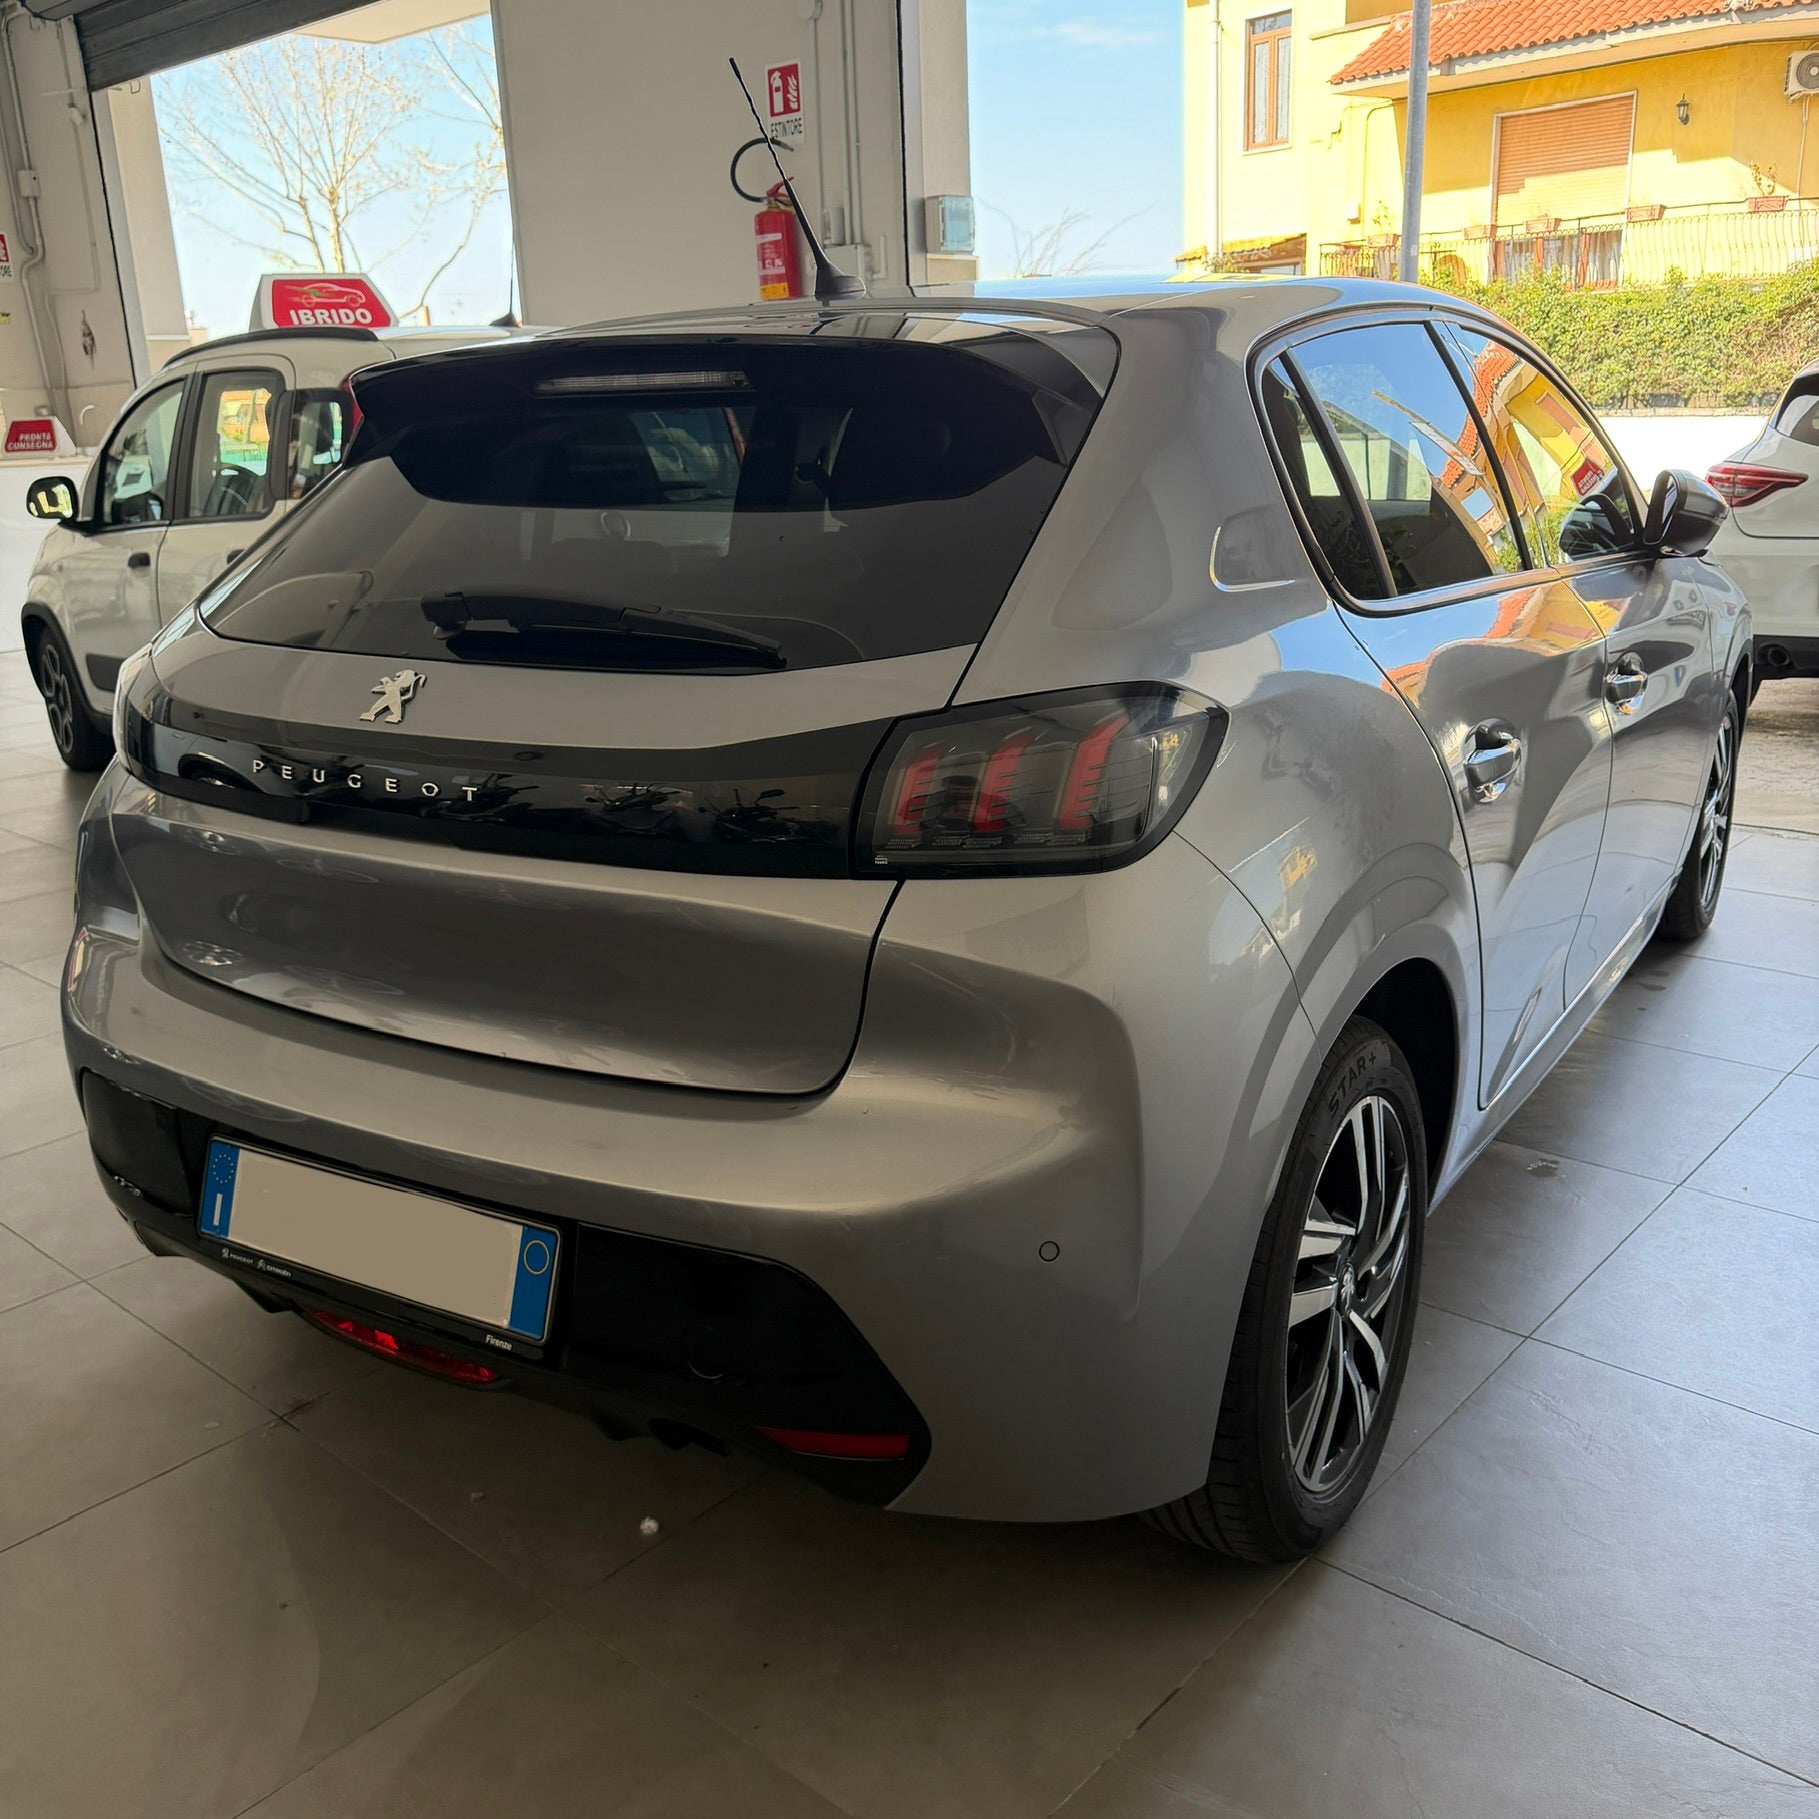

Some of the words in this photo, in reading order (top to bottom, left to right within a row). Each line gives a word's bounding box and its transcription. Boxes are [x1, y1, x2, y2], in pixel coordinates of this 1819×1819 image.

[770, 117, 803, 139] ESTINTORE
[288, 307, 374, 326] IBRIDO
[19, 431, 52, 441] PRONTA
[6, 440, 54, 451] CONSEGNA
[252, 759, 478, 802] PEUGEOT
[229, 1252, 254, 1265] PEUGEOT
[485, 1333, 513, 1351] Firenze
